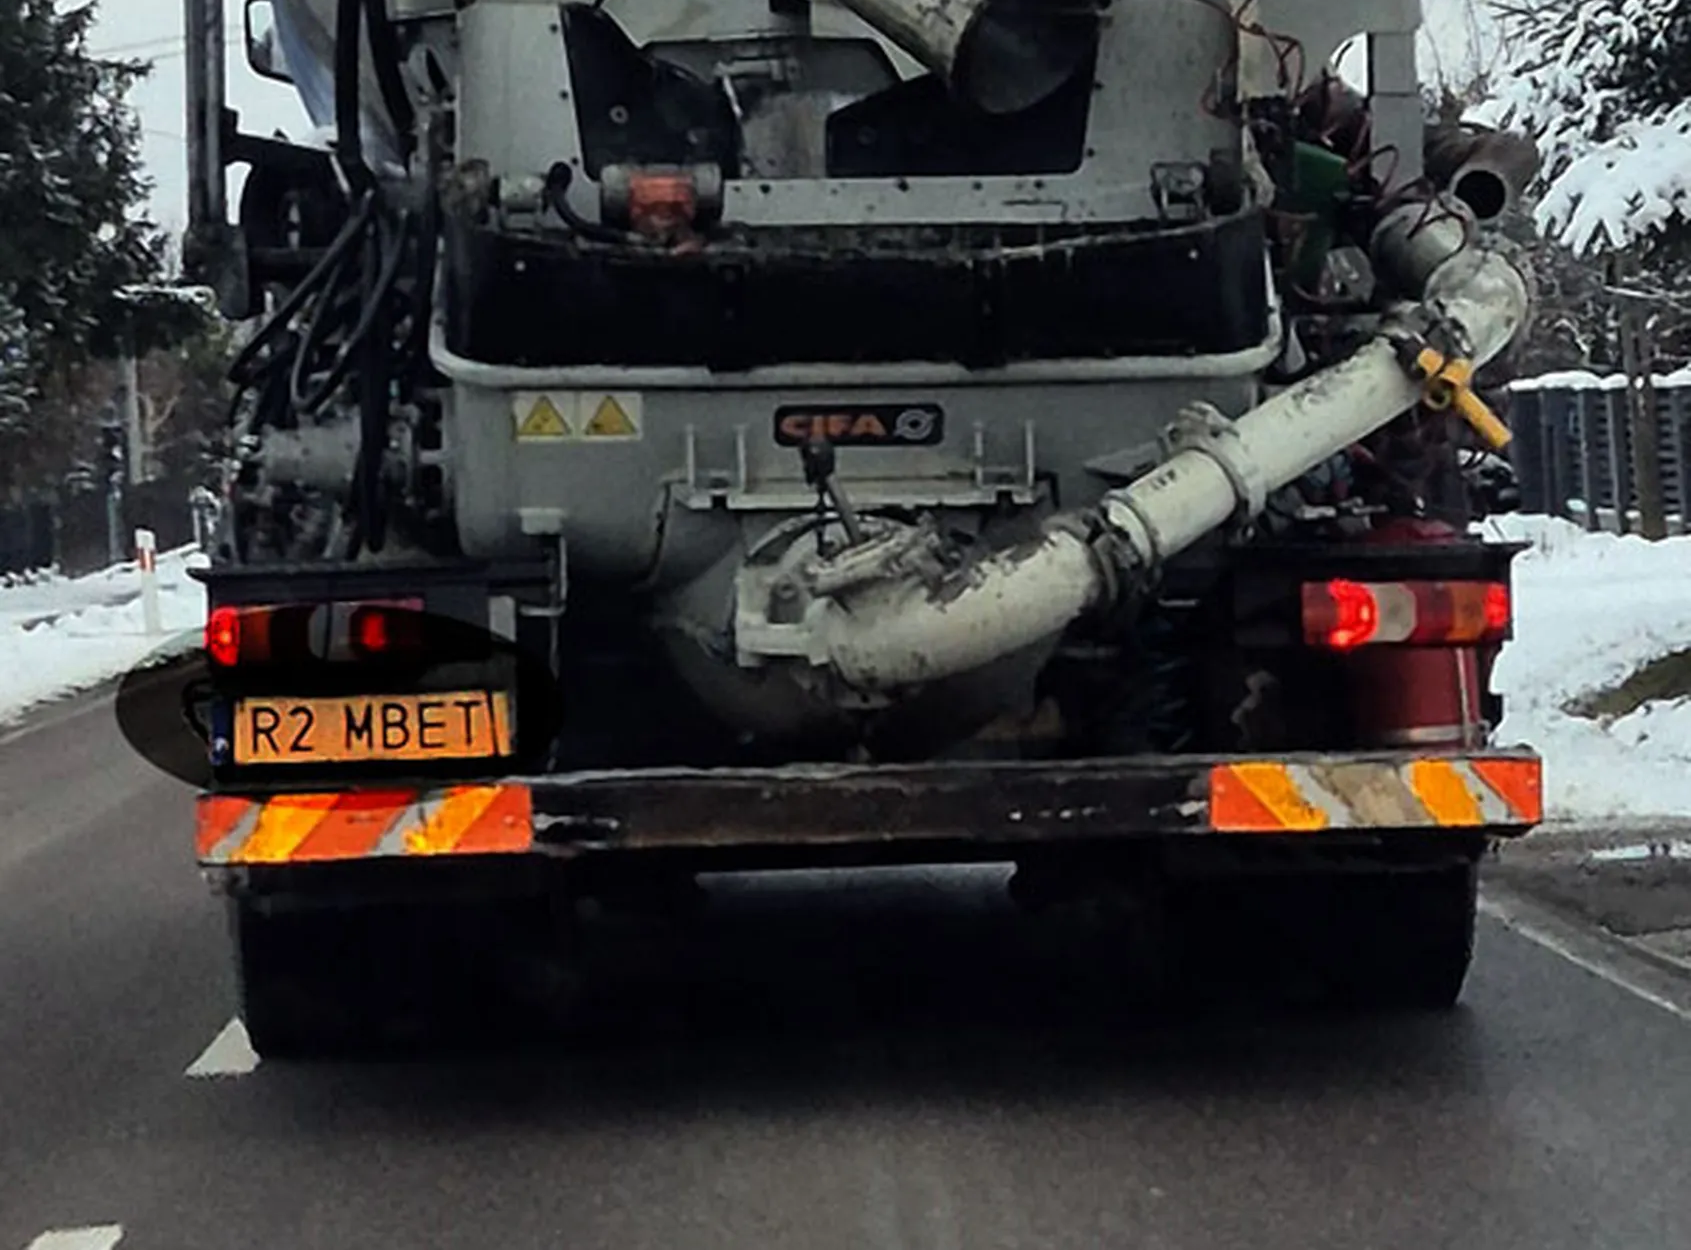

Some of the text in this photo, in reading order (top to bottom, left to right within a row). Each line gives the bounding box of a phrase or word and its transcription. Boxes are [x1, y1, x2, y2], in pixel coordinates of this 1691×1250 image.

[780, 414, 888, 438] CIFA
[251, 701, 482, 755] R2 MBET
